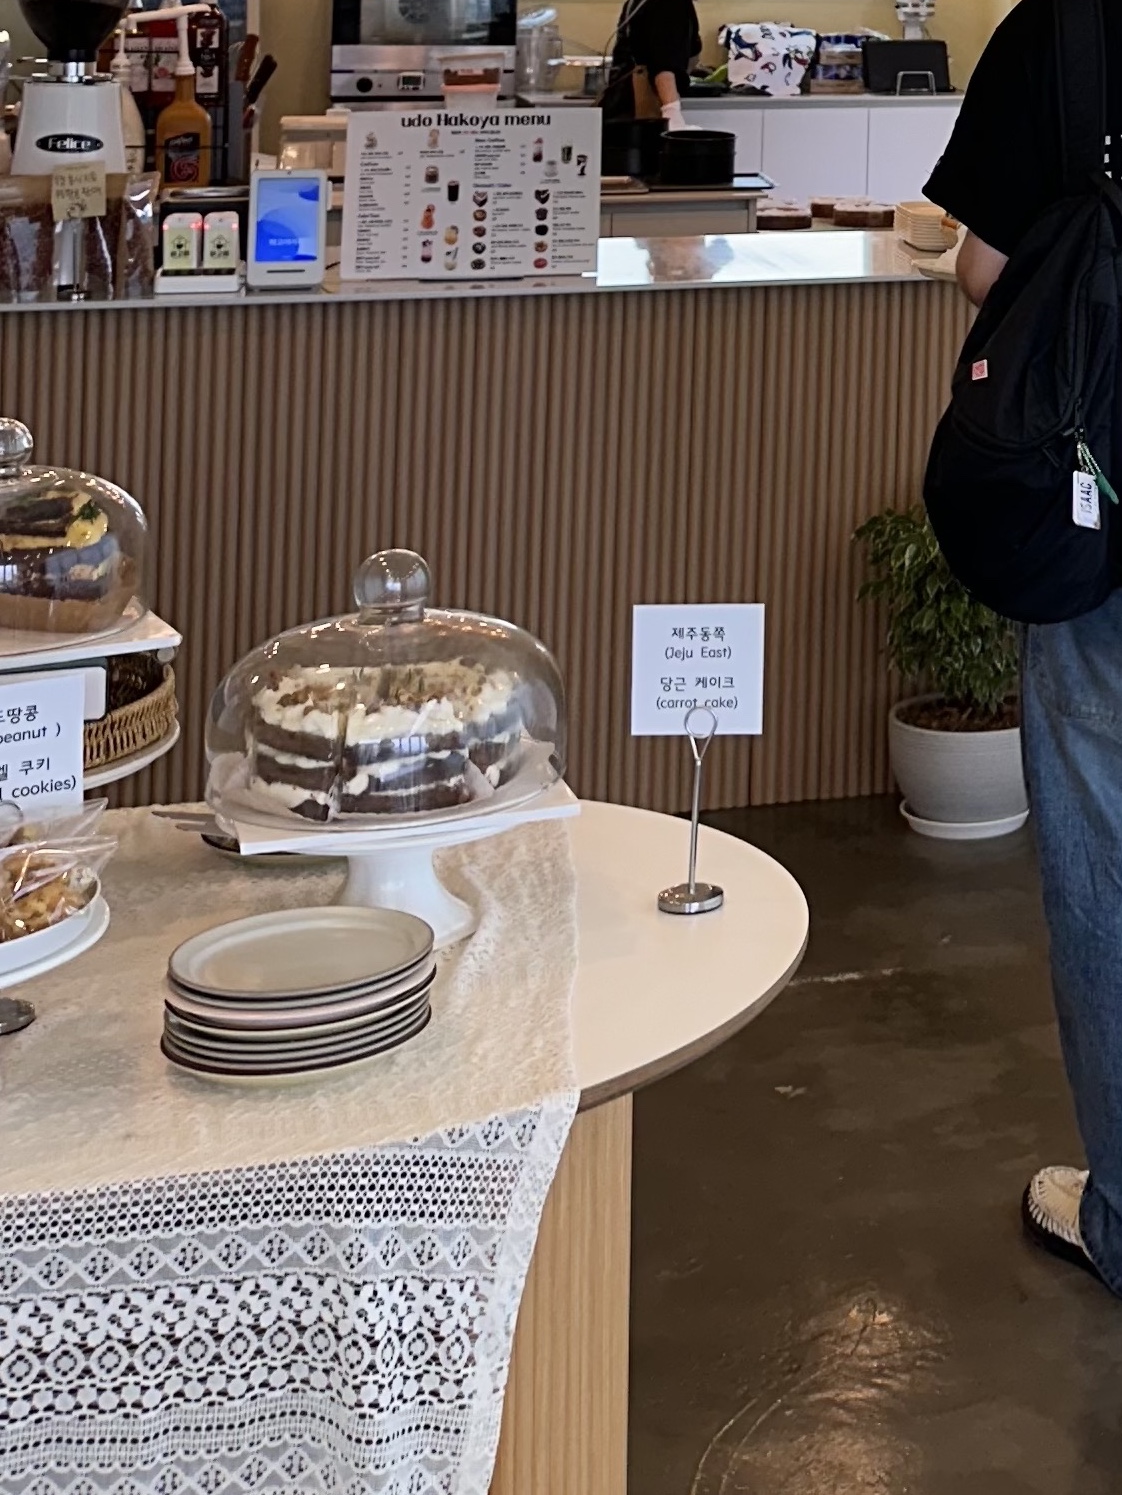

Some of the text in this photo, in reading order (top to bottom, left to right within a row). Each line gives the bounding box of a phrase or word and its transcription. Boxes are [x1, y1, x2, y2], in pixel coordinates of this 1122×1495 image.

[401, 113, 551, 129] udo Hakoya menu
[48, 137, 91, 150] Felice
[1080, 482, 1093, 514] ISAAC
[671, 626, 726, 642] 제주동쪽
[665, 646, 732, 661] (Jeju East)
[660, 676, 735, 692] 당근 케이크
[656, 696, 738, 710] (carrot cake)
[18, 757, 50, 777] 쿠키
[11, 775, 76, 799] cookies)
